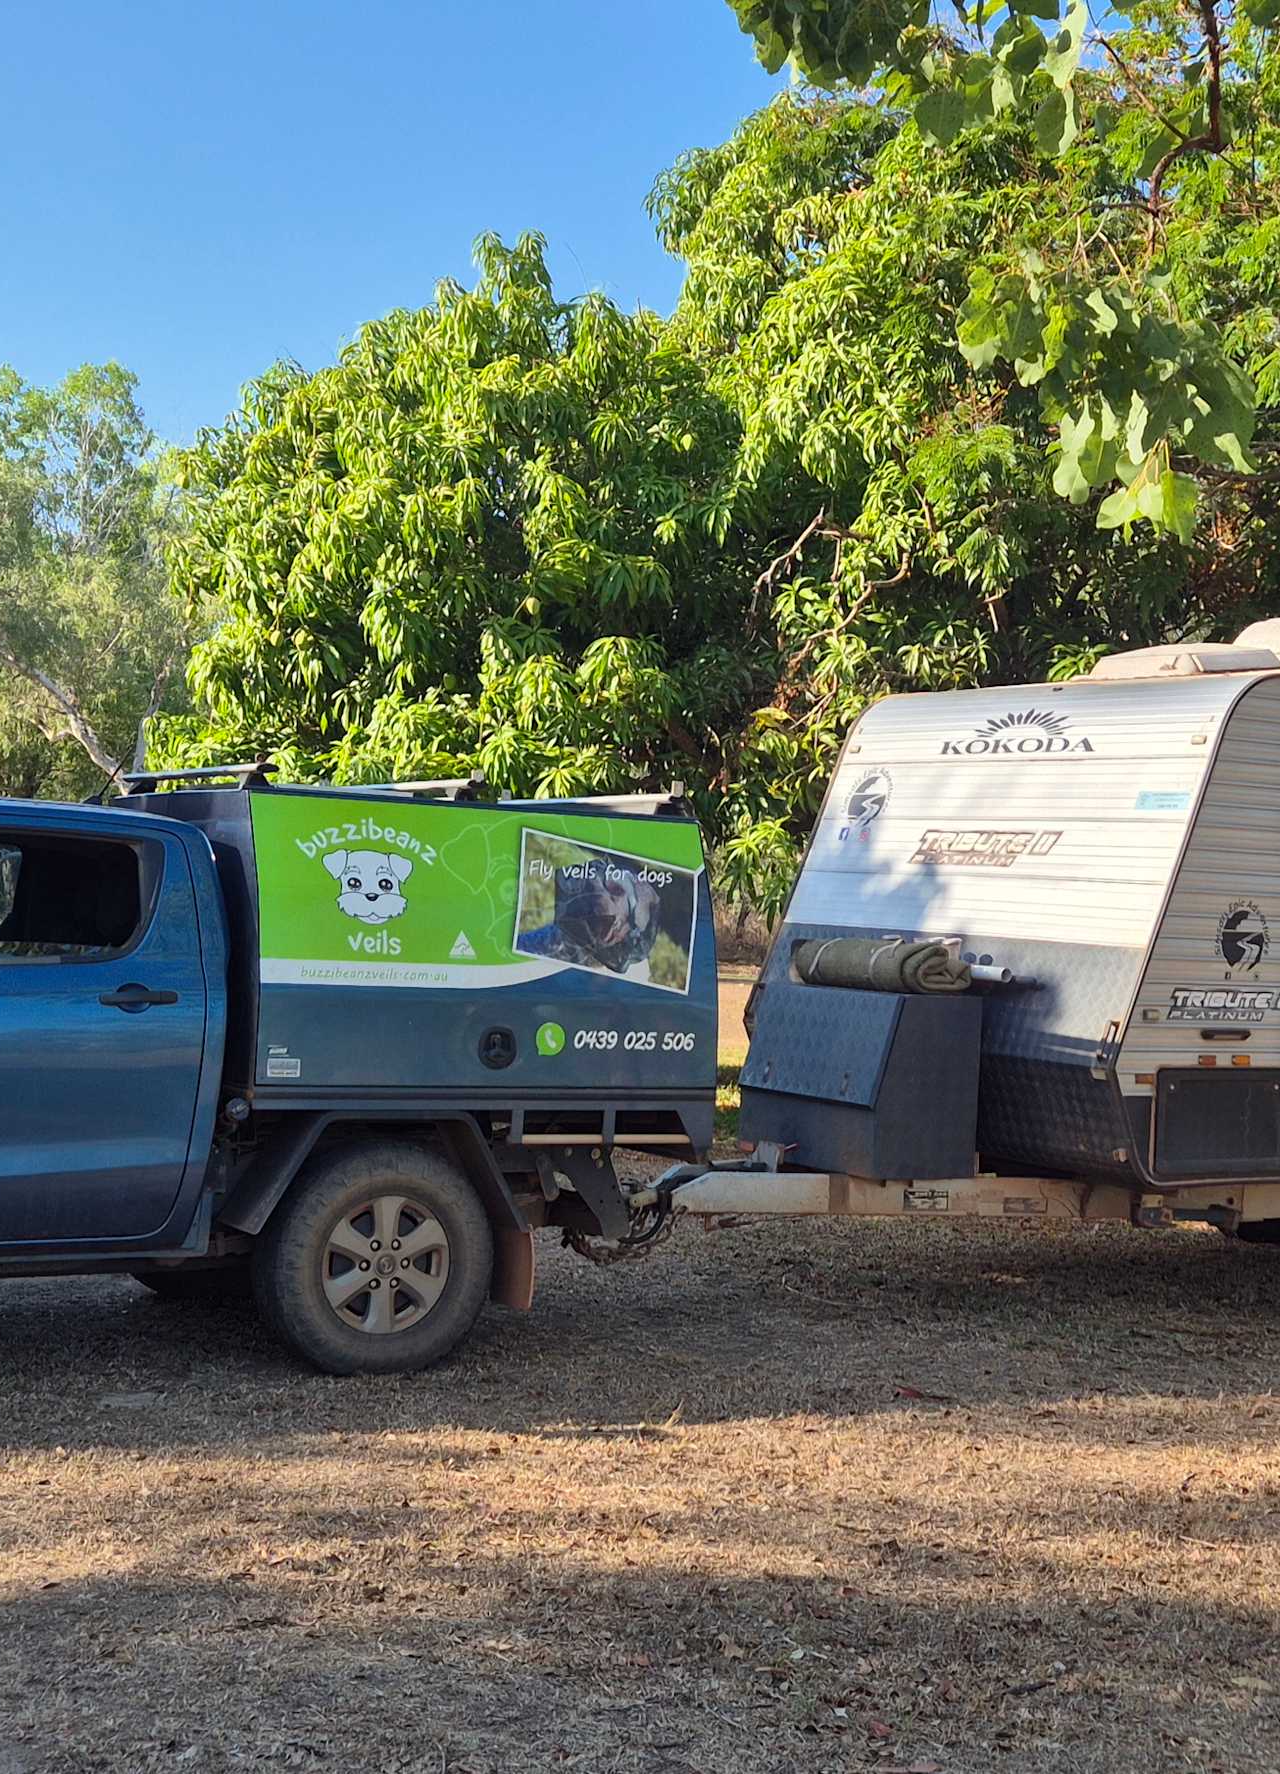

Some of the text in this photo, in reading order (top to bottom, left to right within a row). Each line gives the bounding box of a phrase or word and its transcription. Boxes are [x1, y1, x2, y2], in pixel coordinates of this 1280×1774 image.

[940, 737, 1096, 756] KOKODA
[295, 816, 438, 866] buzzibeanz
[920, 831, 1035, 855] TRIBUTE
[909, 854, 1018, 867] PLATINUM
[529, 859, 673, 888] Fly veils for dogs
[347, 929, 402, 956] veils
[1172, 988, 1274, 1009] TRIBUTE
[1168, 1009, 1264, 1021] PLATINUM
[574, 1030, 696, 1052] 0439 025 506
